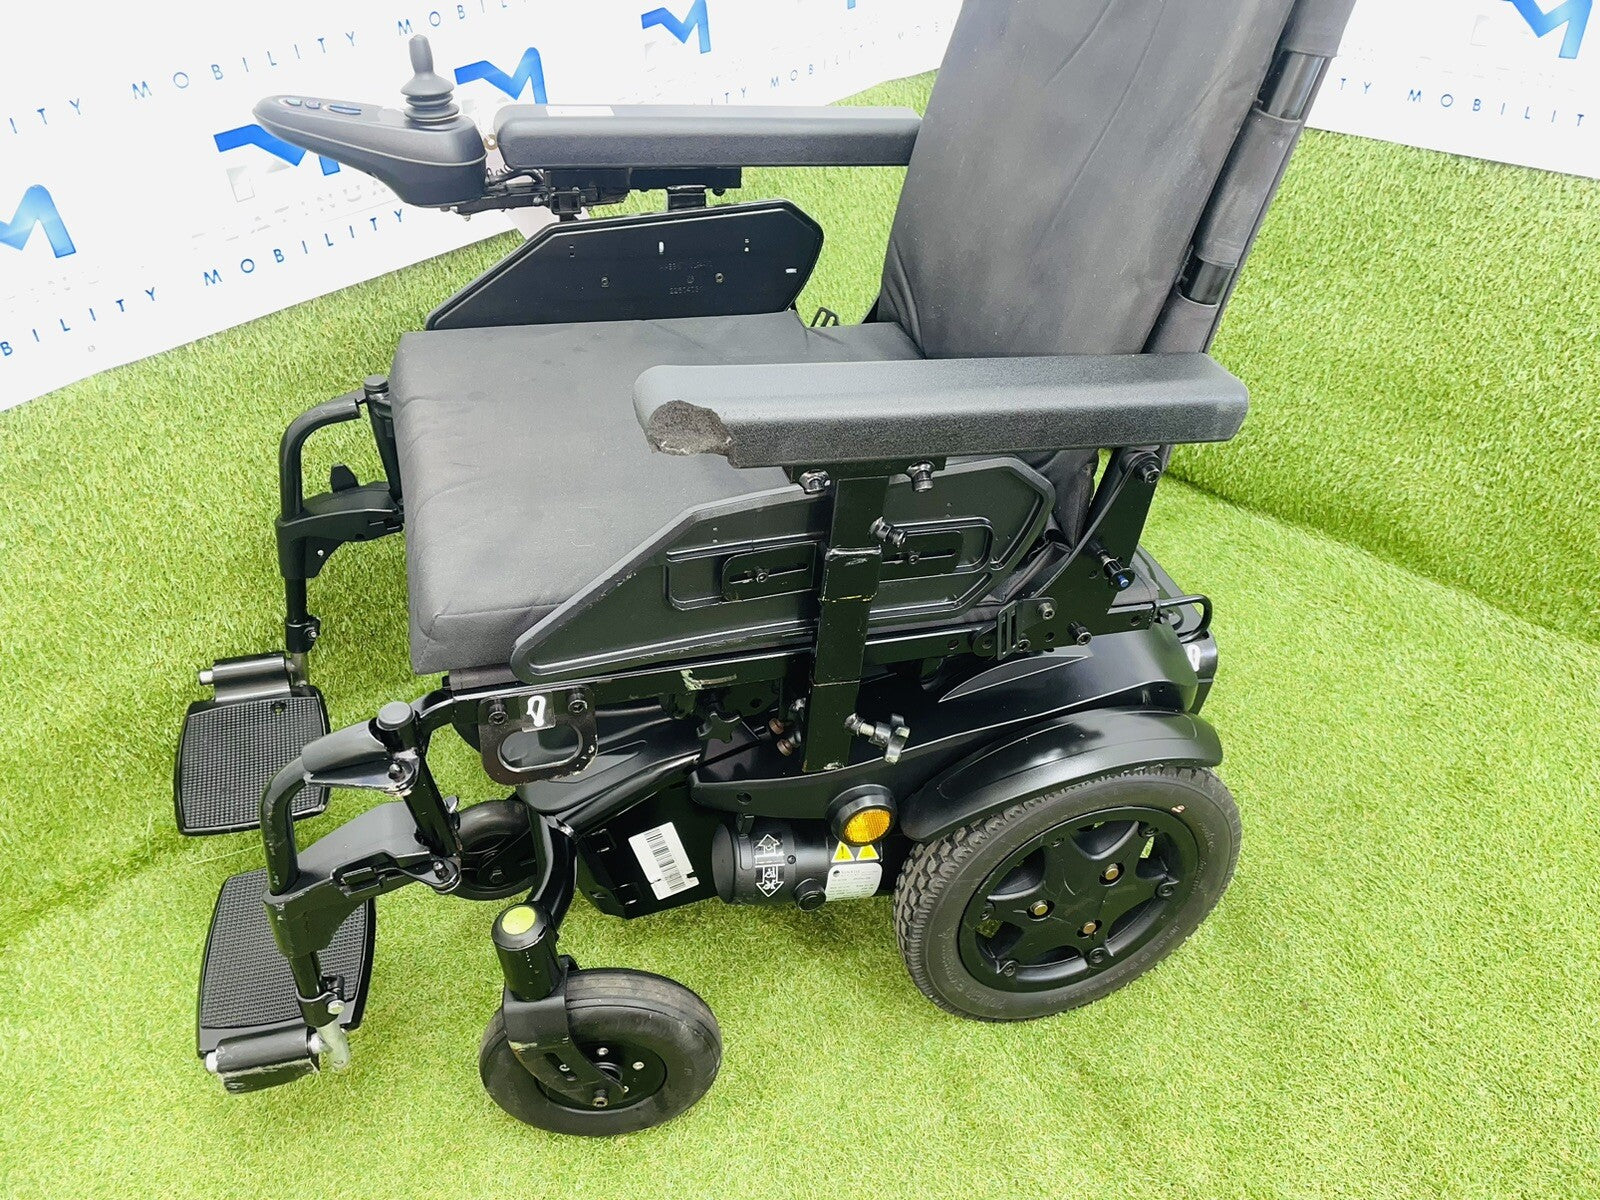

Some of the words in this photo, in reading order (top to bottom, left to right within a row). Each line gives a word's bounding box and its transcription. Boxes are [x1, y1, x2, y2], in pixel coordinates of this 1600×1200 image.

[131, 31, 358, 101] MOBILITY
[9, 98, 81, 135] ITY
[203, 208, 406, 287] MOBILITY
[0, 286, 156, 357] BILITY
